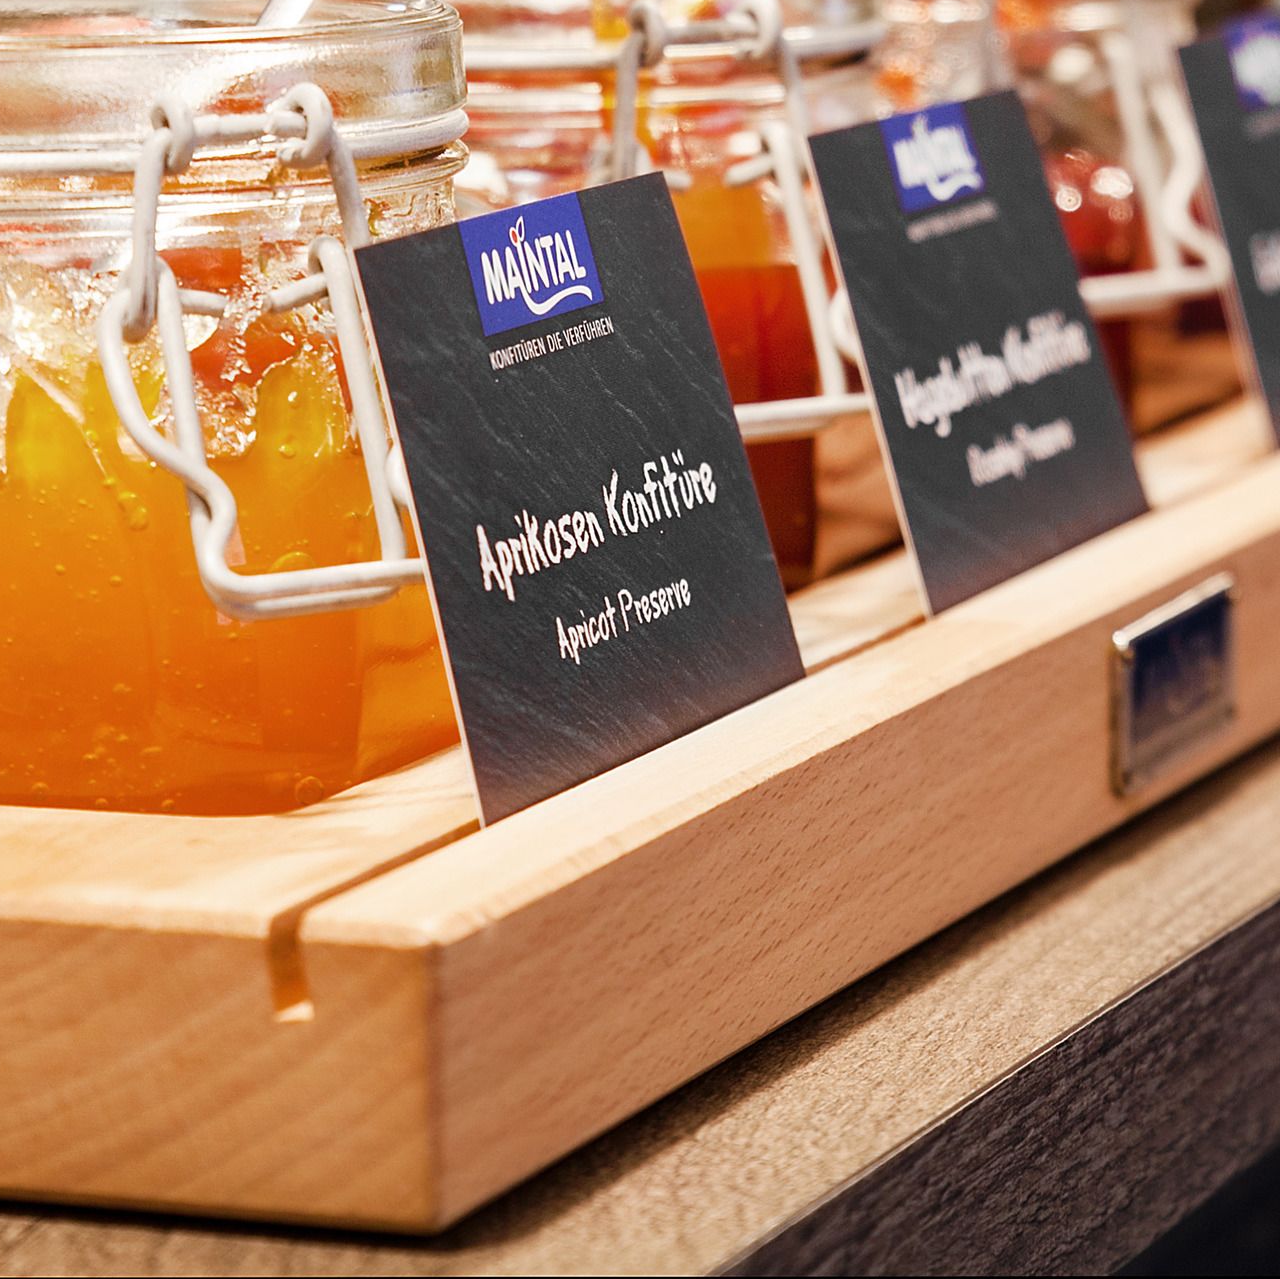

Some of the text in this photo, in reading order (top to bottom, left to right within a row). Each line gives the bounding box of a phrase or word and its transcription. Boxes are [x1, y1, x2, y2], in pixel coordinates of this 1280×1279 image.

[480, 227, 587, 306] MAINTAL
[488, 316, 615, 371] KONFITÜREN DIE VERFÜHREN
[476, 448, 717, 602] Aprikosen Konfitüre
[556, 579, 691, 665] Apricot Preserve
